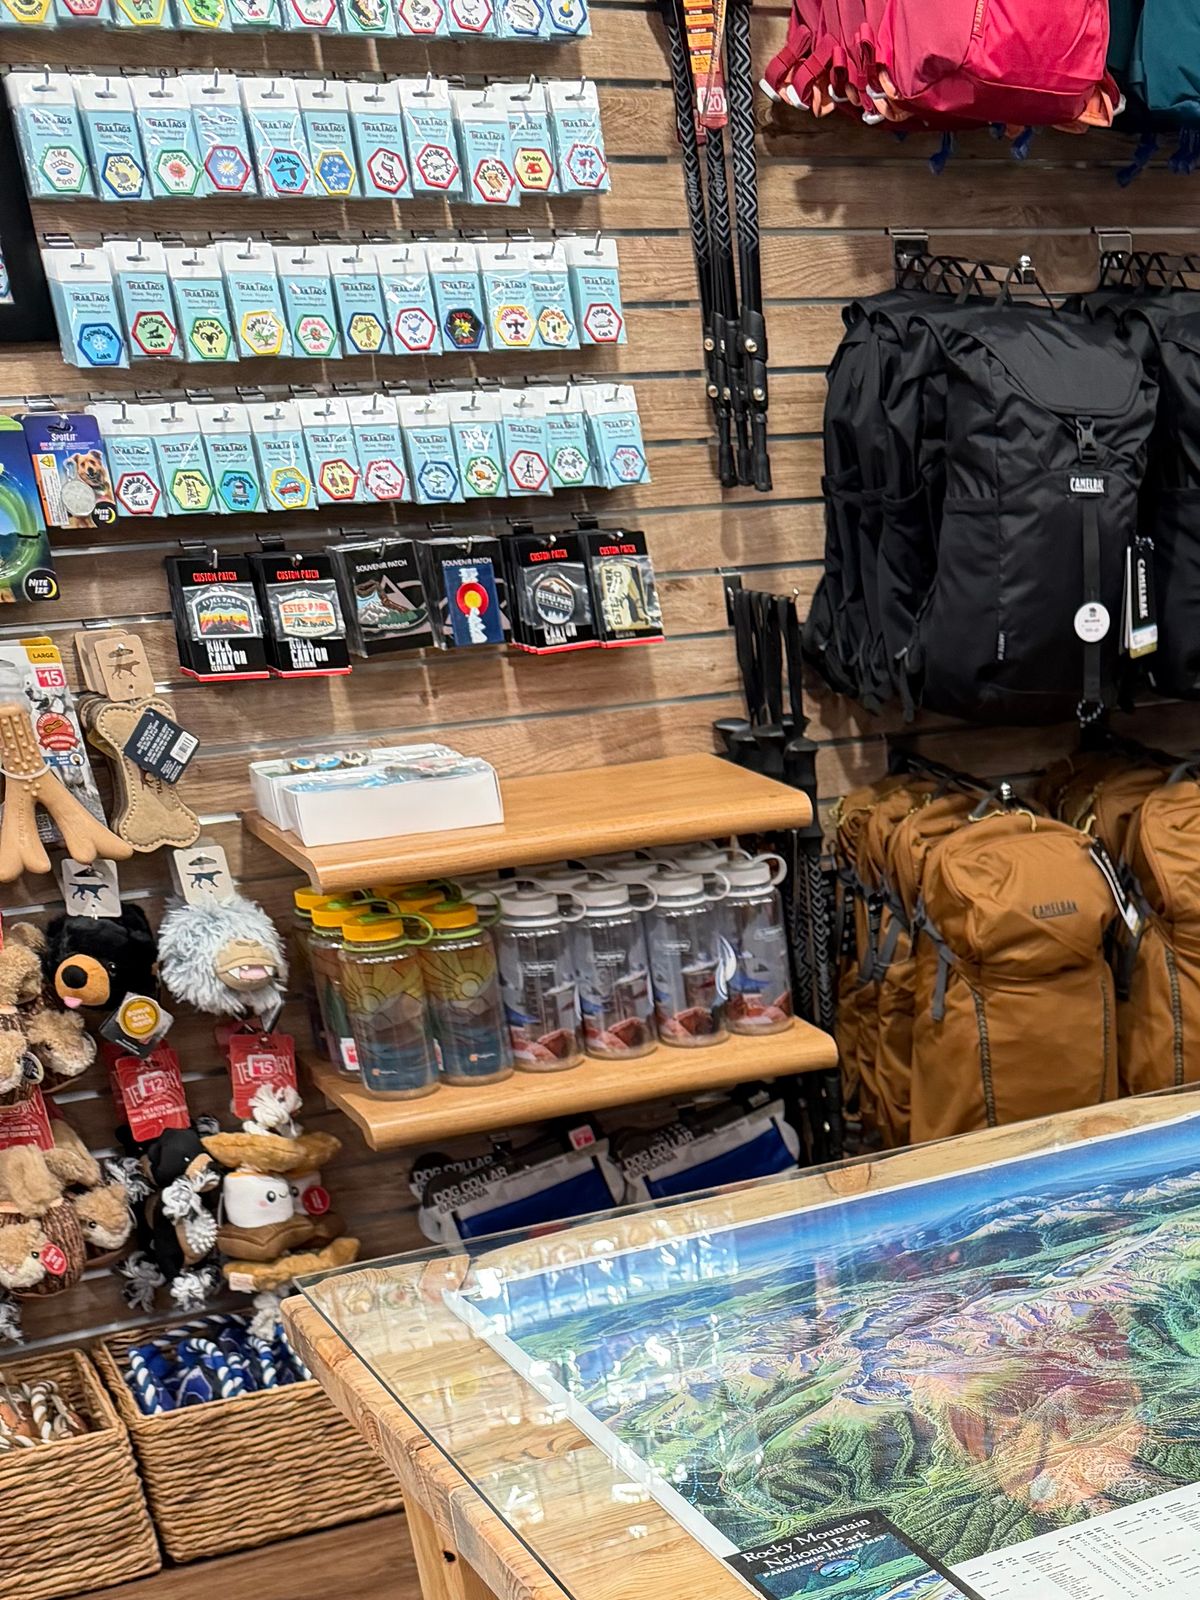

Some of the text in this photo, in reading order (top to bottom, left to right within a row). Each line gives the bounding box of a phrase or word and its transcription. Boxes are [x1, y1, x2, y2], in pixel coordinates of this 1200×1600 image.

[355, 559, 408, 573] SOUVENIR PATCH
[442, 556, 492, 568] SOUVENIR PATCH
[193, 571, 238, 582] CUSTOM PATCH
[277, 569, 320, 581] CUSTOM PATCH
[28, 579, 48, 587] NITE
[34, 587, 49, 595] IZE
[283, 604, 306, 613] ESTES
[32, 652, 54, 660] LARGE
[208, 650, 248, 665] CANYON
[290, 647, 329, 663] CANYON
[1032, 900, 1079, 920] CAMELBAK
[625, 1131, 695, 1170] DOG COLLAR
[432, 1166, 508, 1204] DOG COLLAR
[438, 1187, 490, 1214] BANDANA
[741, 1518, 871, 1565] Rocky Mountain
[762, 1534, 887, 1578] PANORAMIC HIKING MAP
[764, 1530, 872, 1569] National Park
